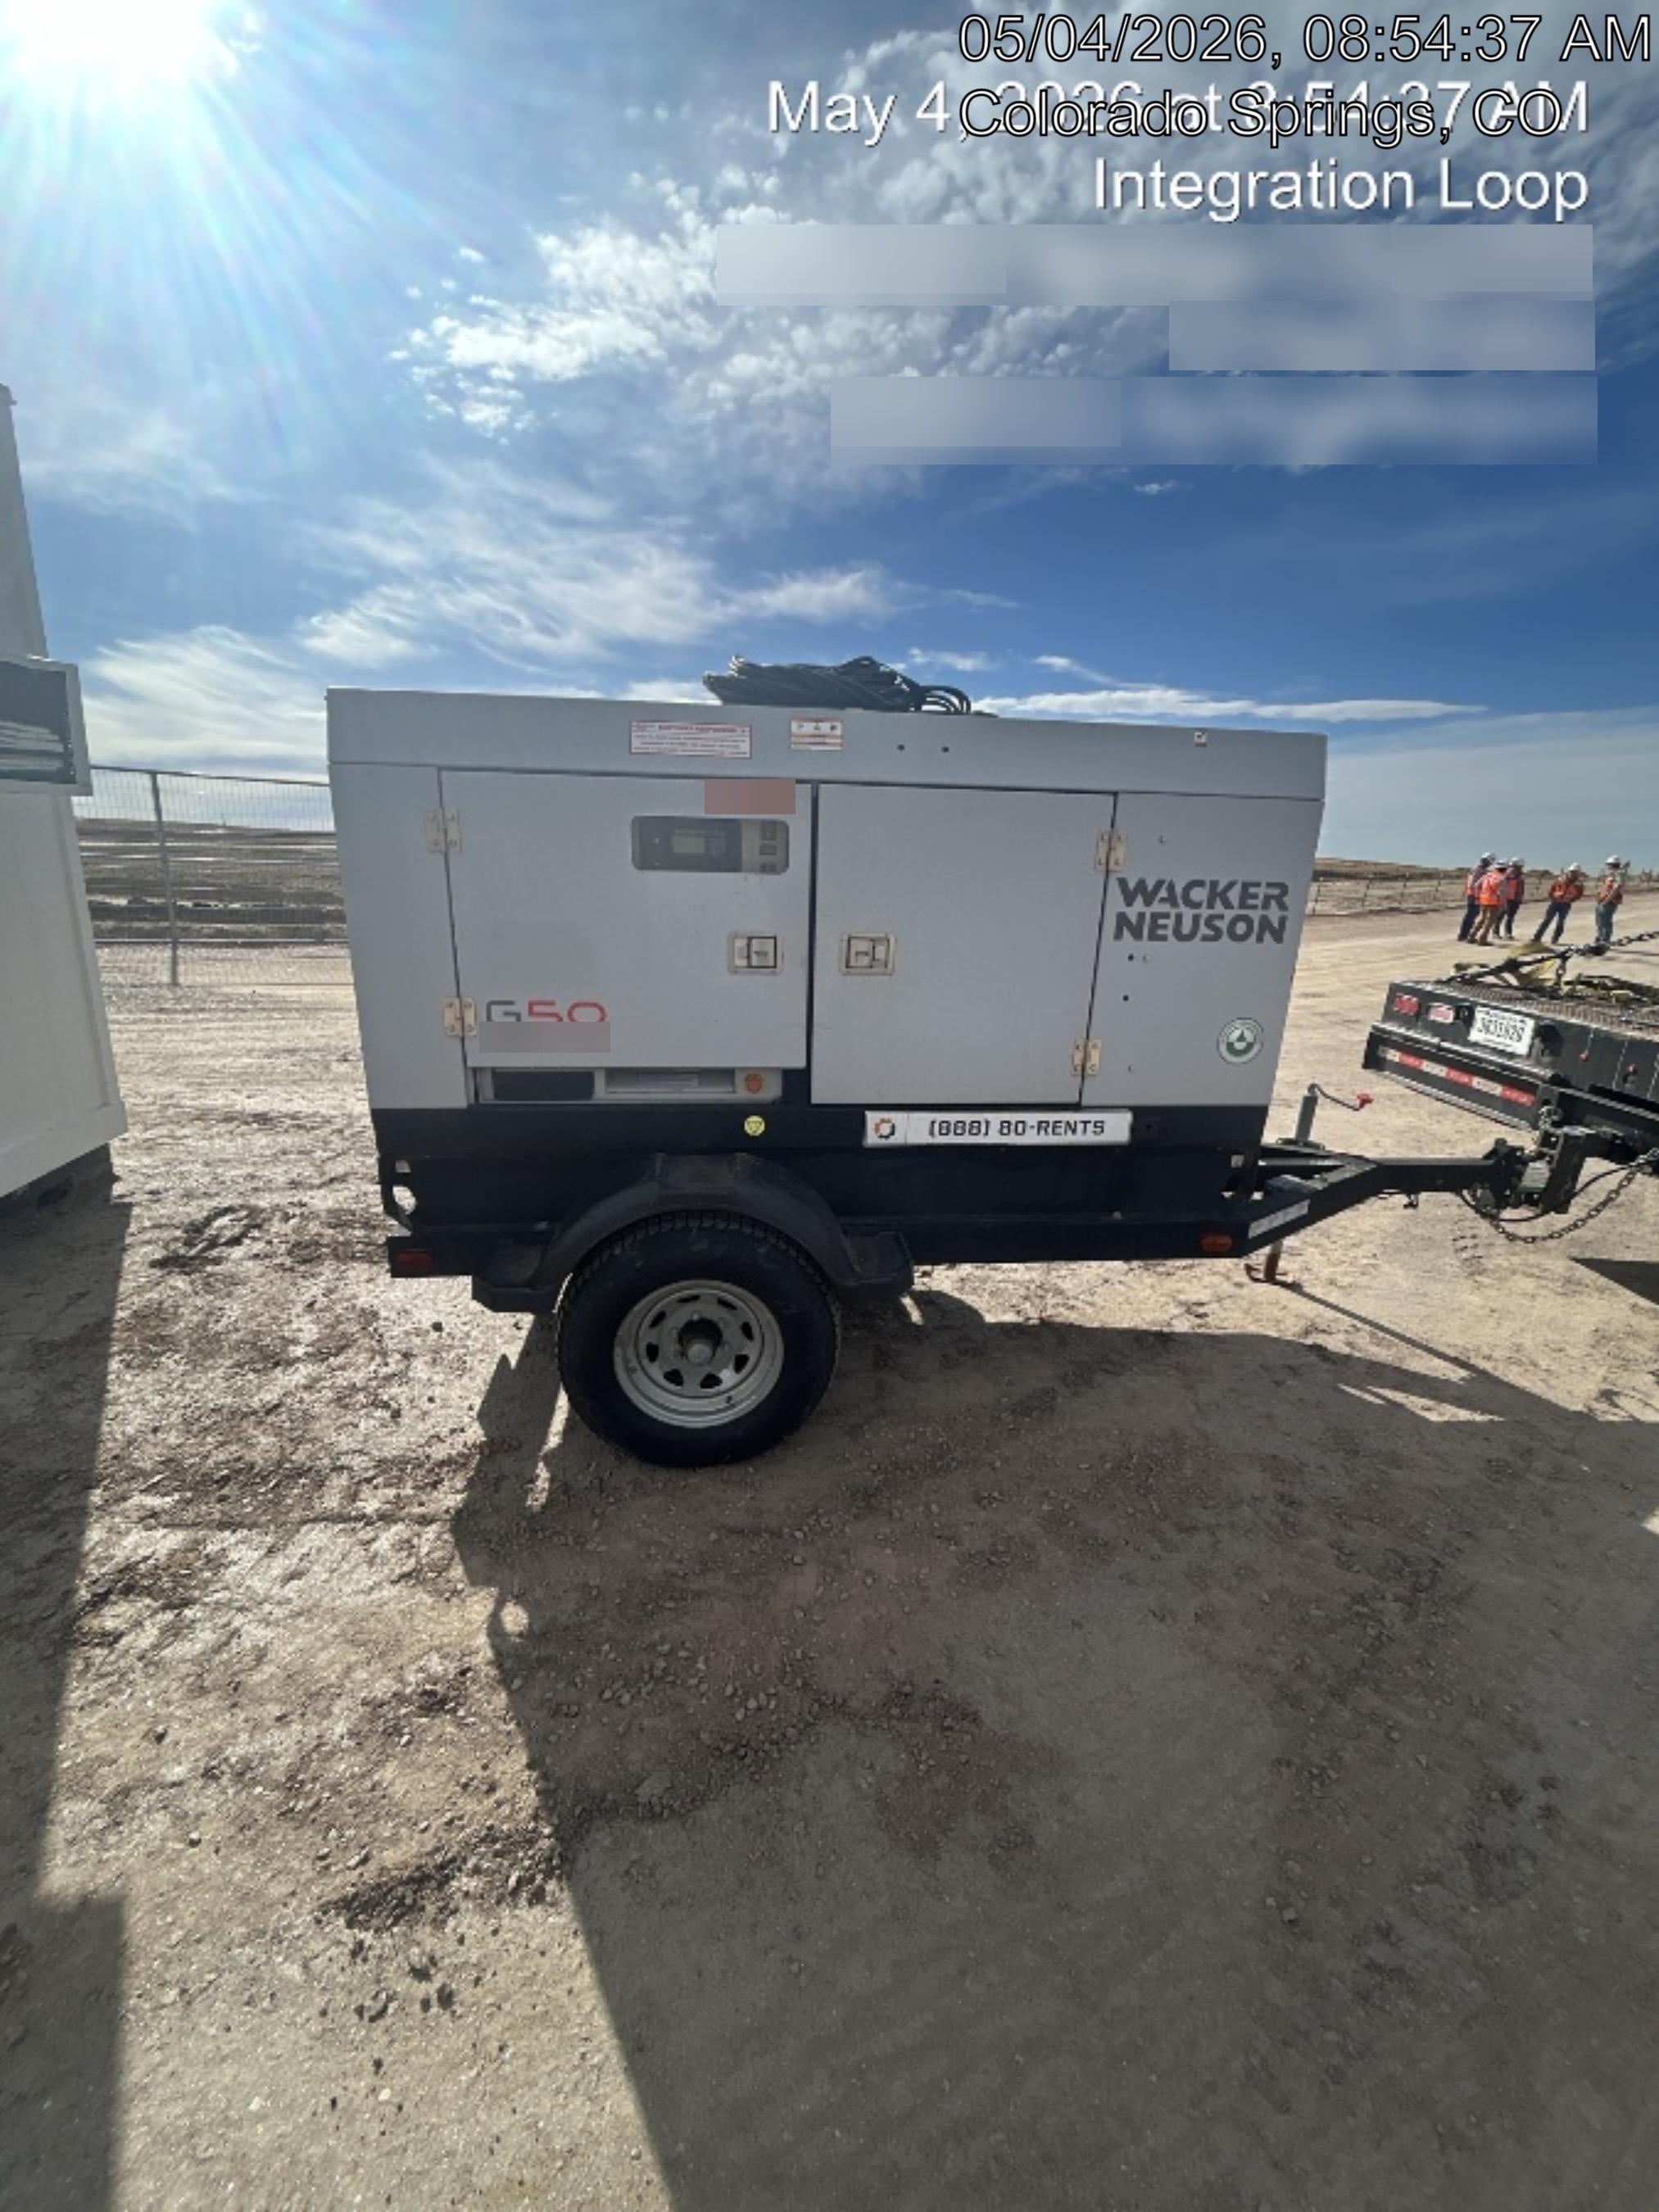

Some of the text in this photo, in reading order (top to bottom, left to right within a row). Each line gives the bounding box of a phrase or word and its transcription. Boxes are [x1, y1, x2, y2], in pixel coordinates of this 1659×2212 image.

[1115, 877, 1290, 912] WACKER
[1113, 911, 1289, 945] NEUSON
[998, 1119, 1106, 1137] 80-RENTS
